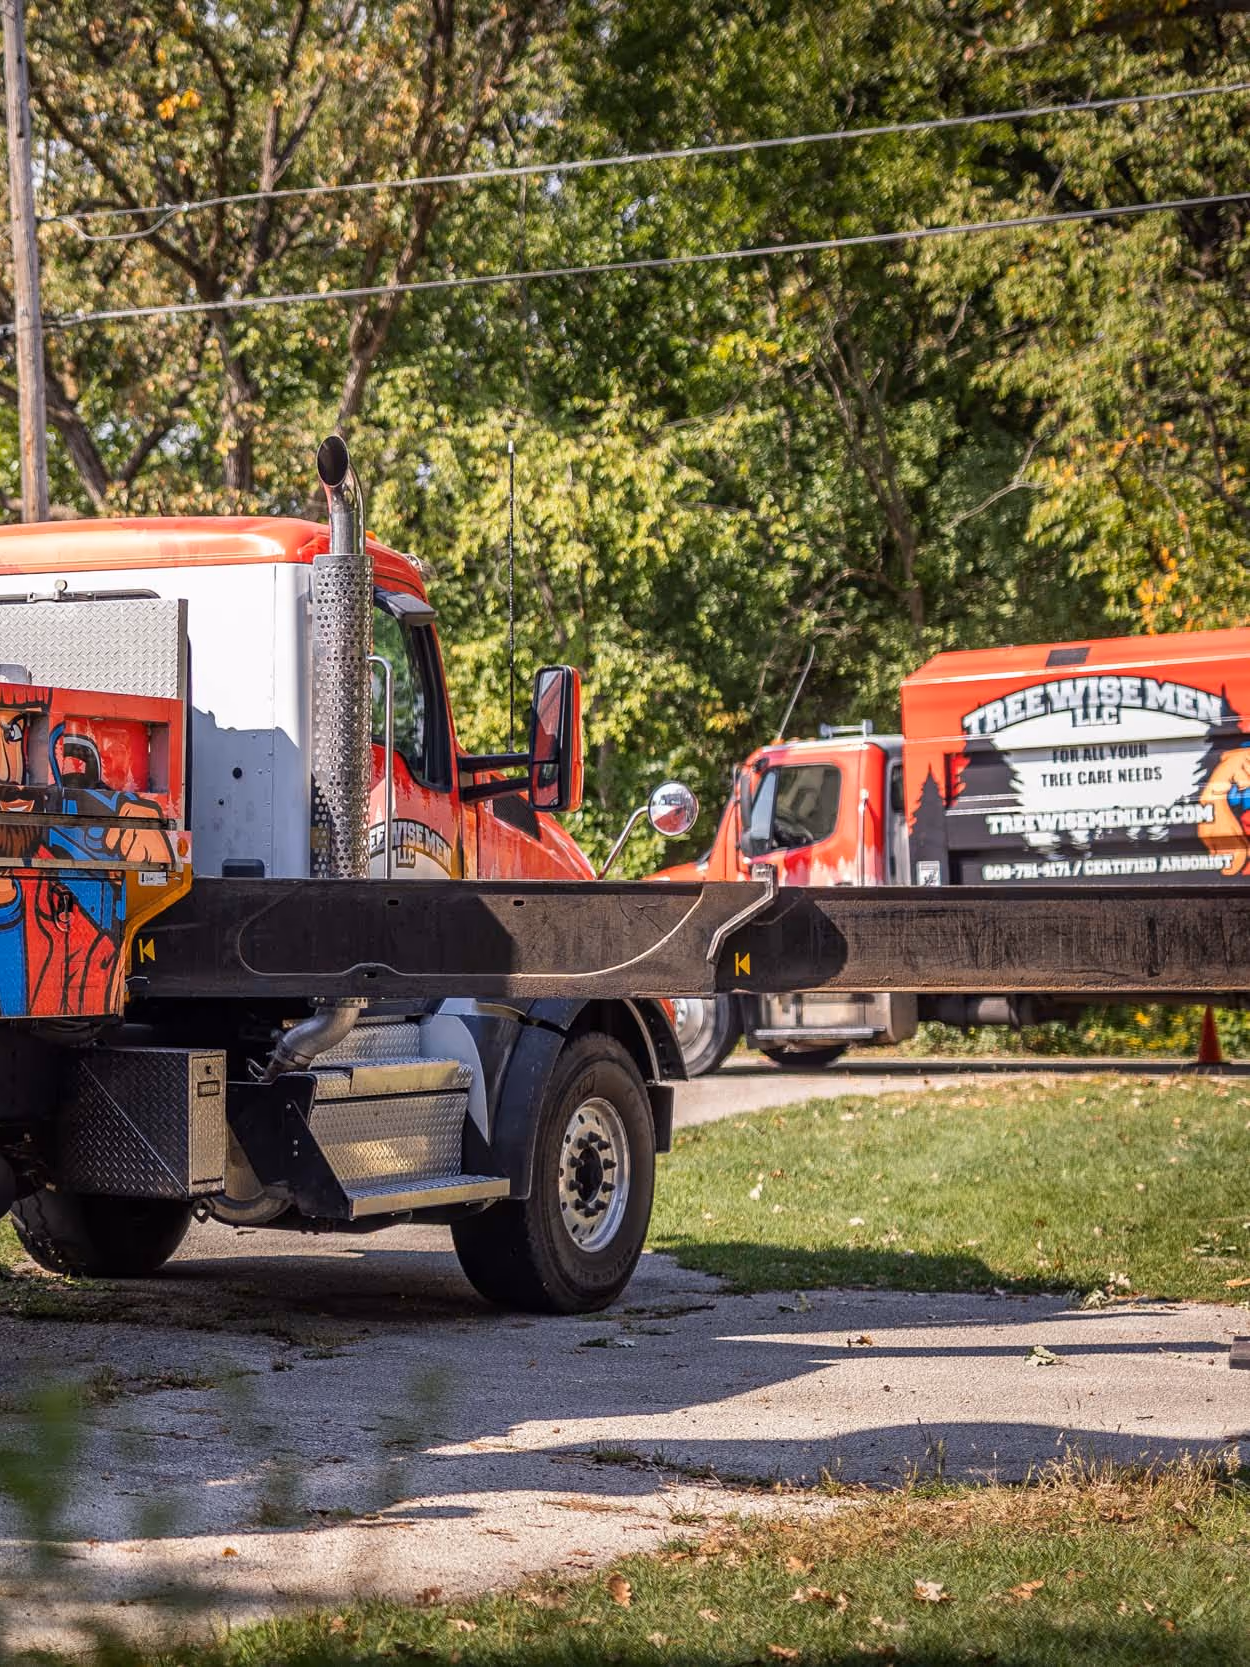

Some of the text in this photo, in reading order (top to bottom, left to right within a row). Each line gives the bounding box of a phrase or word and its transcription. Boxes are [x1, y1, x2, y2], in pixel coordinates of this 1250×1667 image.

[962, 676, 1222, 735] TREE WISE MEN
[1074, 707, 1119, 725] LLC
[1053, 744, 1149, 763] FOR ALL YOUR
[1041, 767, 1163, 787] TREE CARE NEEDS
[986, 804, 1214, 834] TREEWISEMENLLC.COM
[398, 847, 415, 864] LLC
[1083, 857, 1157, 876] CERTIFIED
[1159, 854, 1233, 872] ARBORIST
